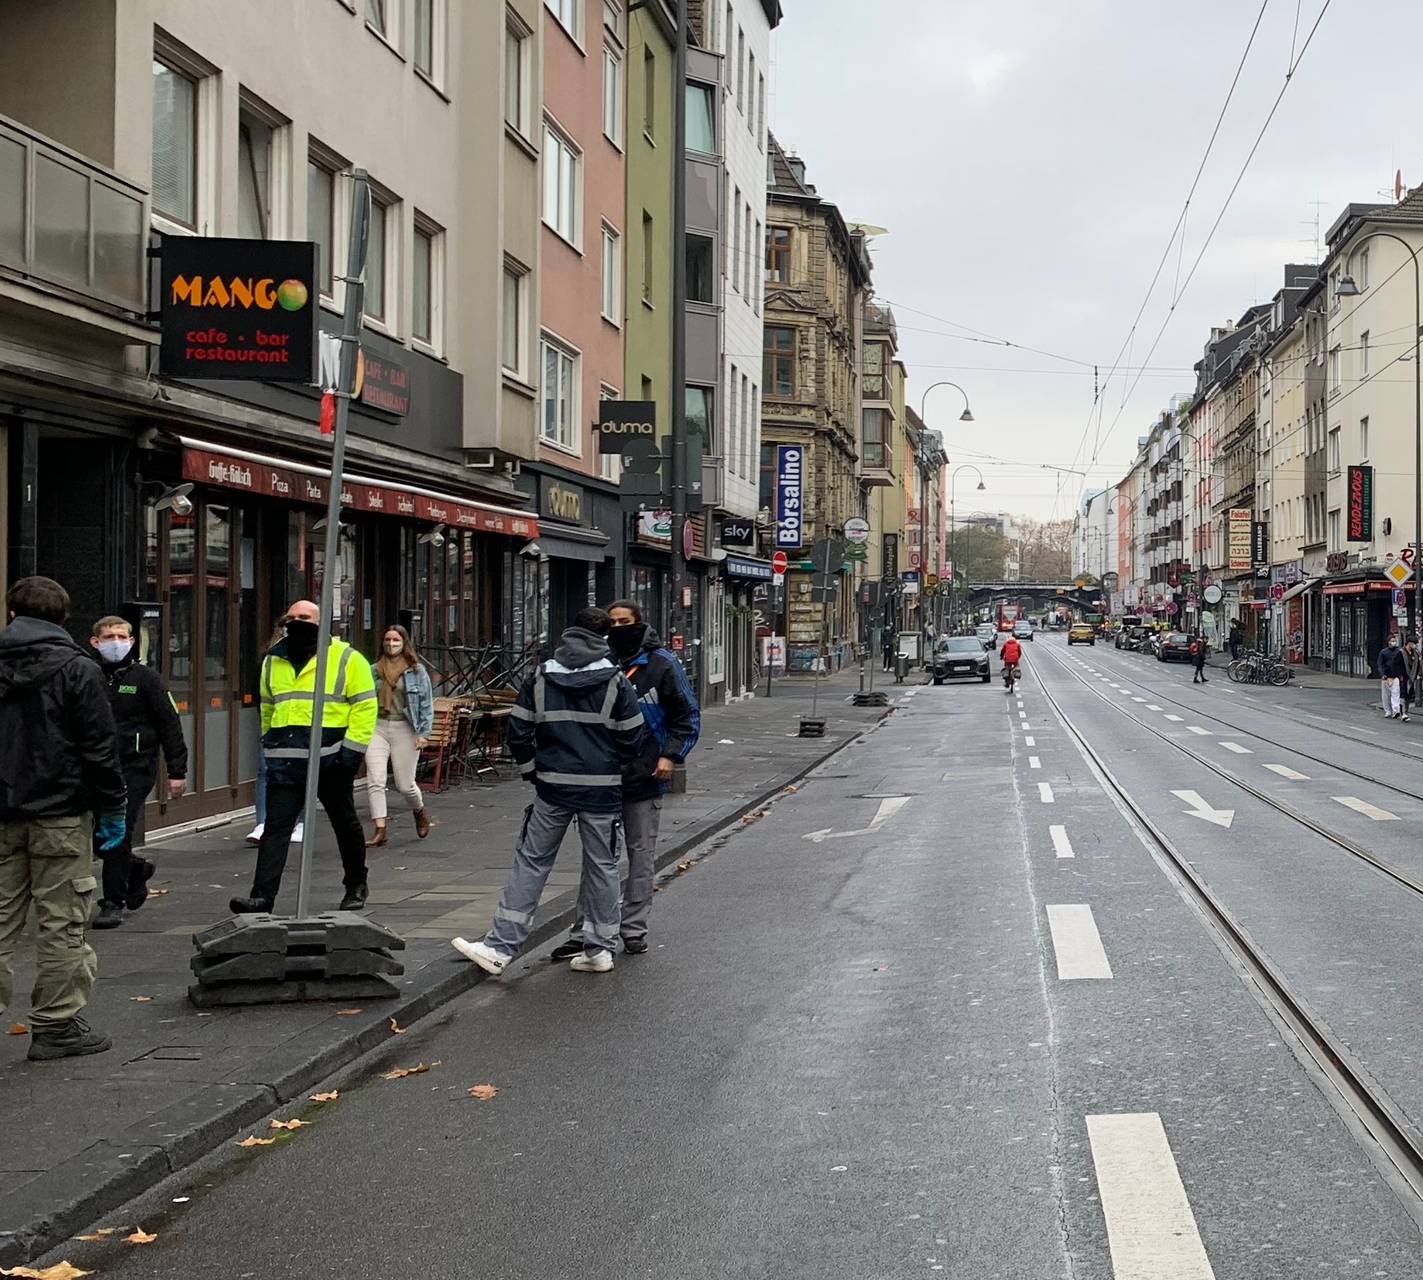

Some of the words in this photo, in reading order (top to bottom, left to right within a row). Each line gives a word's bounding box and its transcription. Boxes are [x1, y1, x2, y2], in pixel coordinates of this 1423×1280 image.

[186, 328, 228, 344] cafe
[256, 330, 289, 345] bar
[185, 345, 289, 362] restaurant
[601, 420, 653, 434] duma
[272, 472, 288, 493] Pizza
[779, 449, 801, 543] Borsalino
[1352, 468, 1363, 538] RENDEZVOUS
[724, 524, 751, 540] sky
